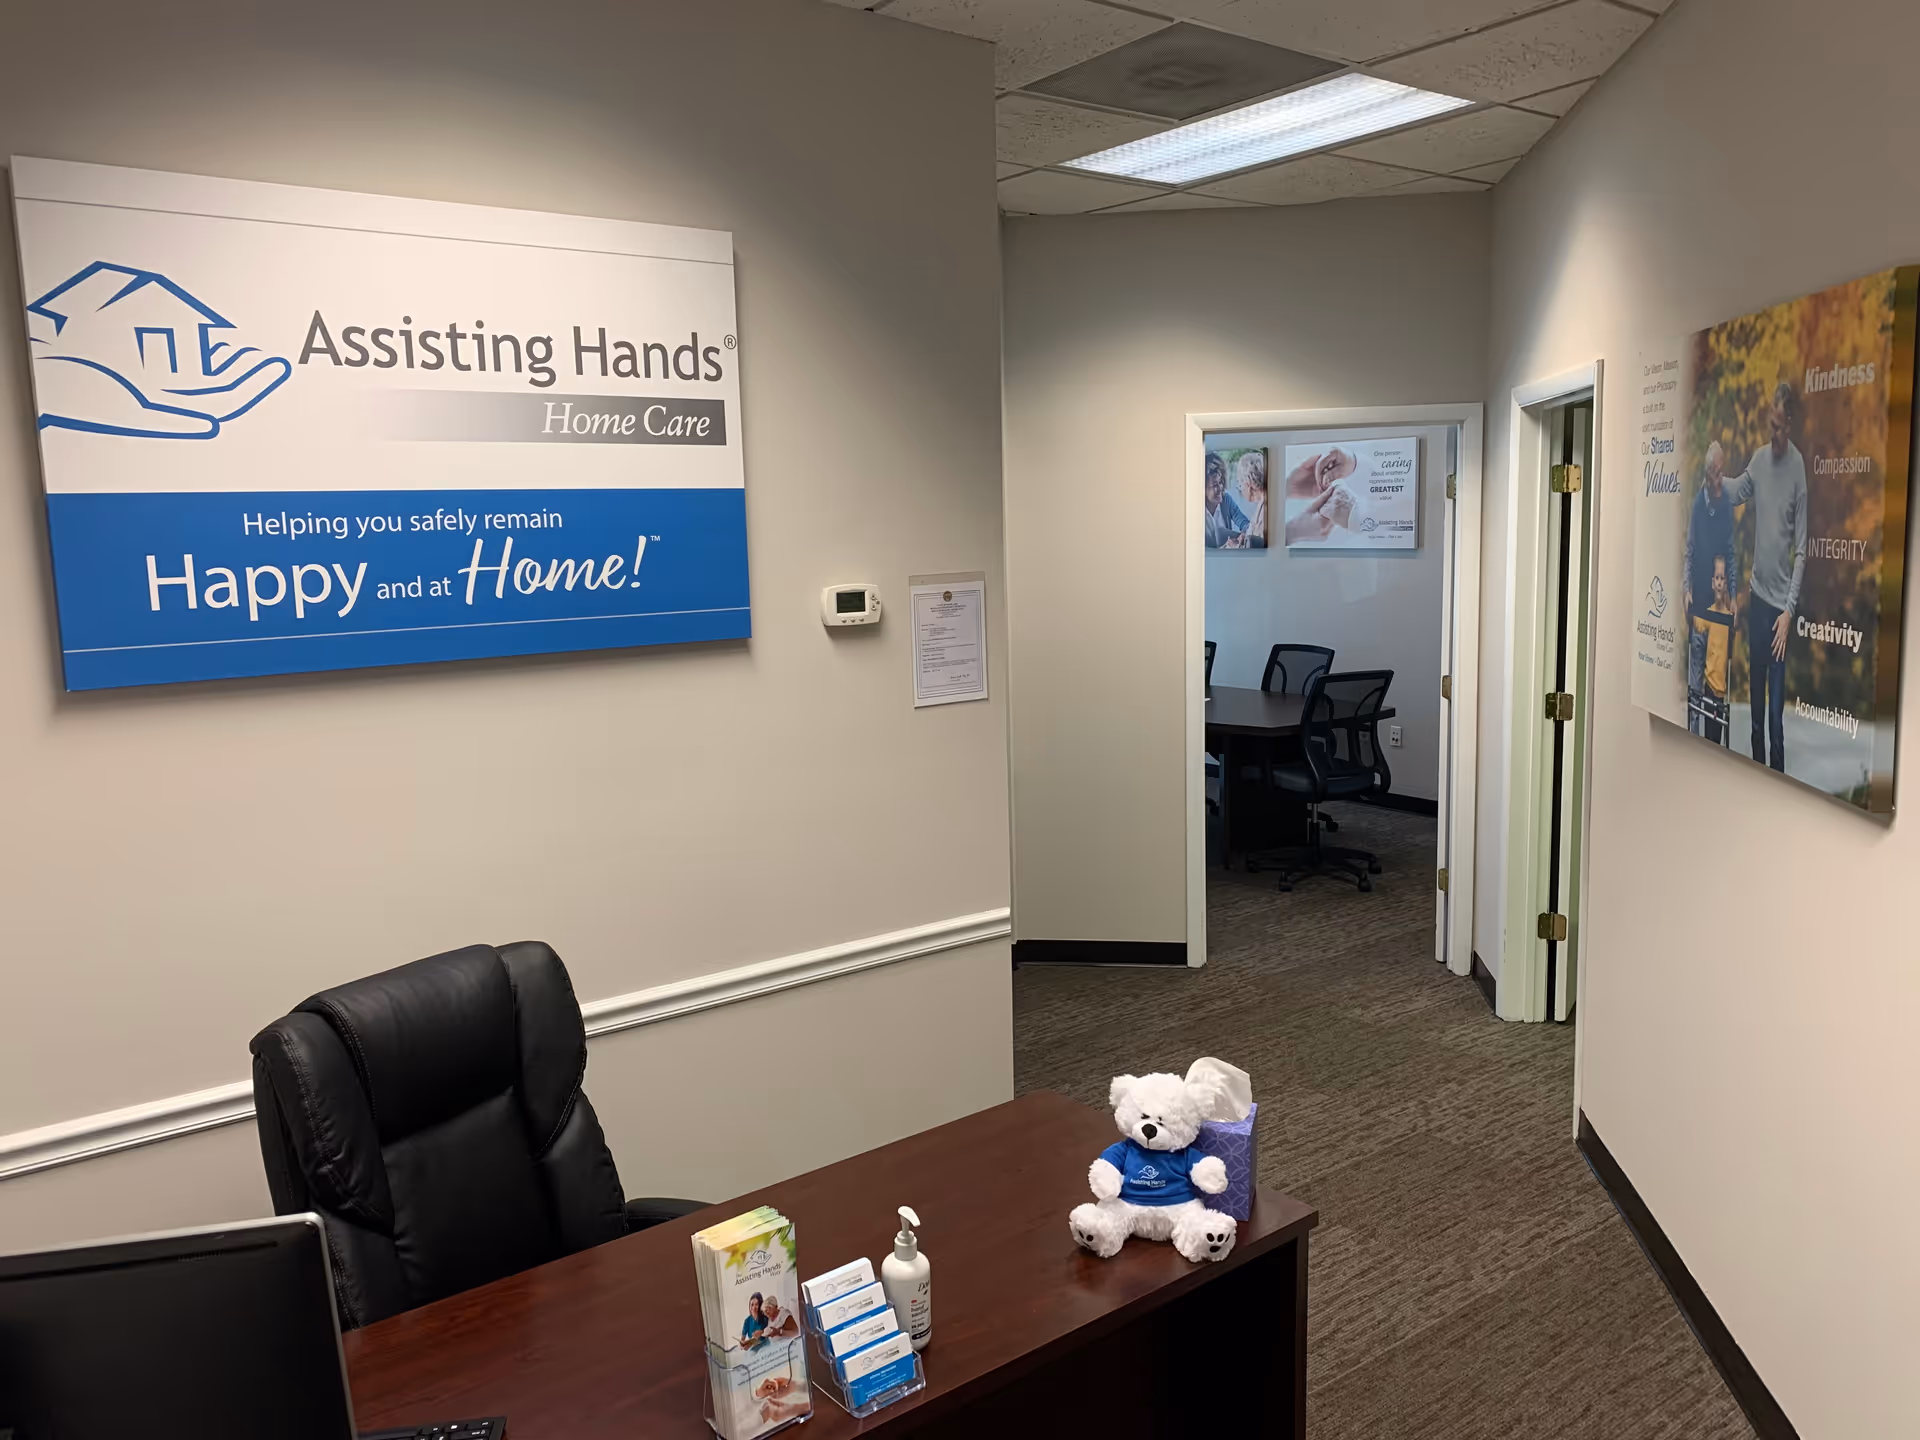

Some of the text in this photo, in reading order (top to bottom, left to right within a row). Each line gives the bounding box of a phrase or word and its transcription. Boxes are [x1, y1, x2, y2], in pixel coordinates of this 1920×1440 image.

[298, 310, 557, 388] Assisting
[1804, 361, 1876, 394] Kindness
[542, 401, 711, 437] Home Care
[1651, 433, 1675, 455] Shared
[1381, 456, 1412, 474] caring
[1813, 452, 1871, 479] Compassion
[1369, 485, 1404, 493] GREATEST
[243, 509, 563, 540] Helping you safely remain
[1808, 537, 1868, 562] INTEGRITY
[145, 553, 368, 621] Happy
[376, 576, 423, 600] and
[429, 576, 452, 597] at
[1637, 619, 1657, 641] Assisting
[1796, 615, 1863, 653] Creativity
[1795, 696, 1859, 740] Accountability
[734, 1270, 762, 1287] Assisting
